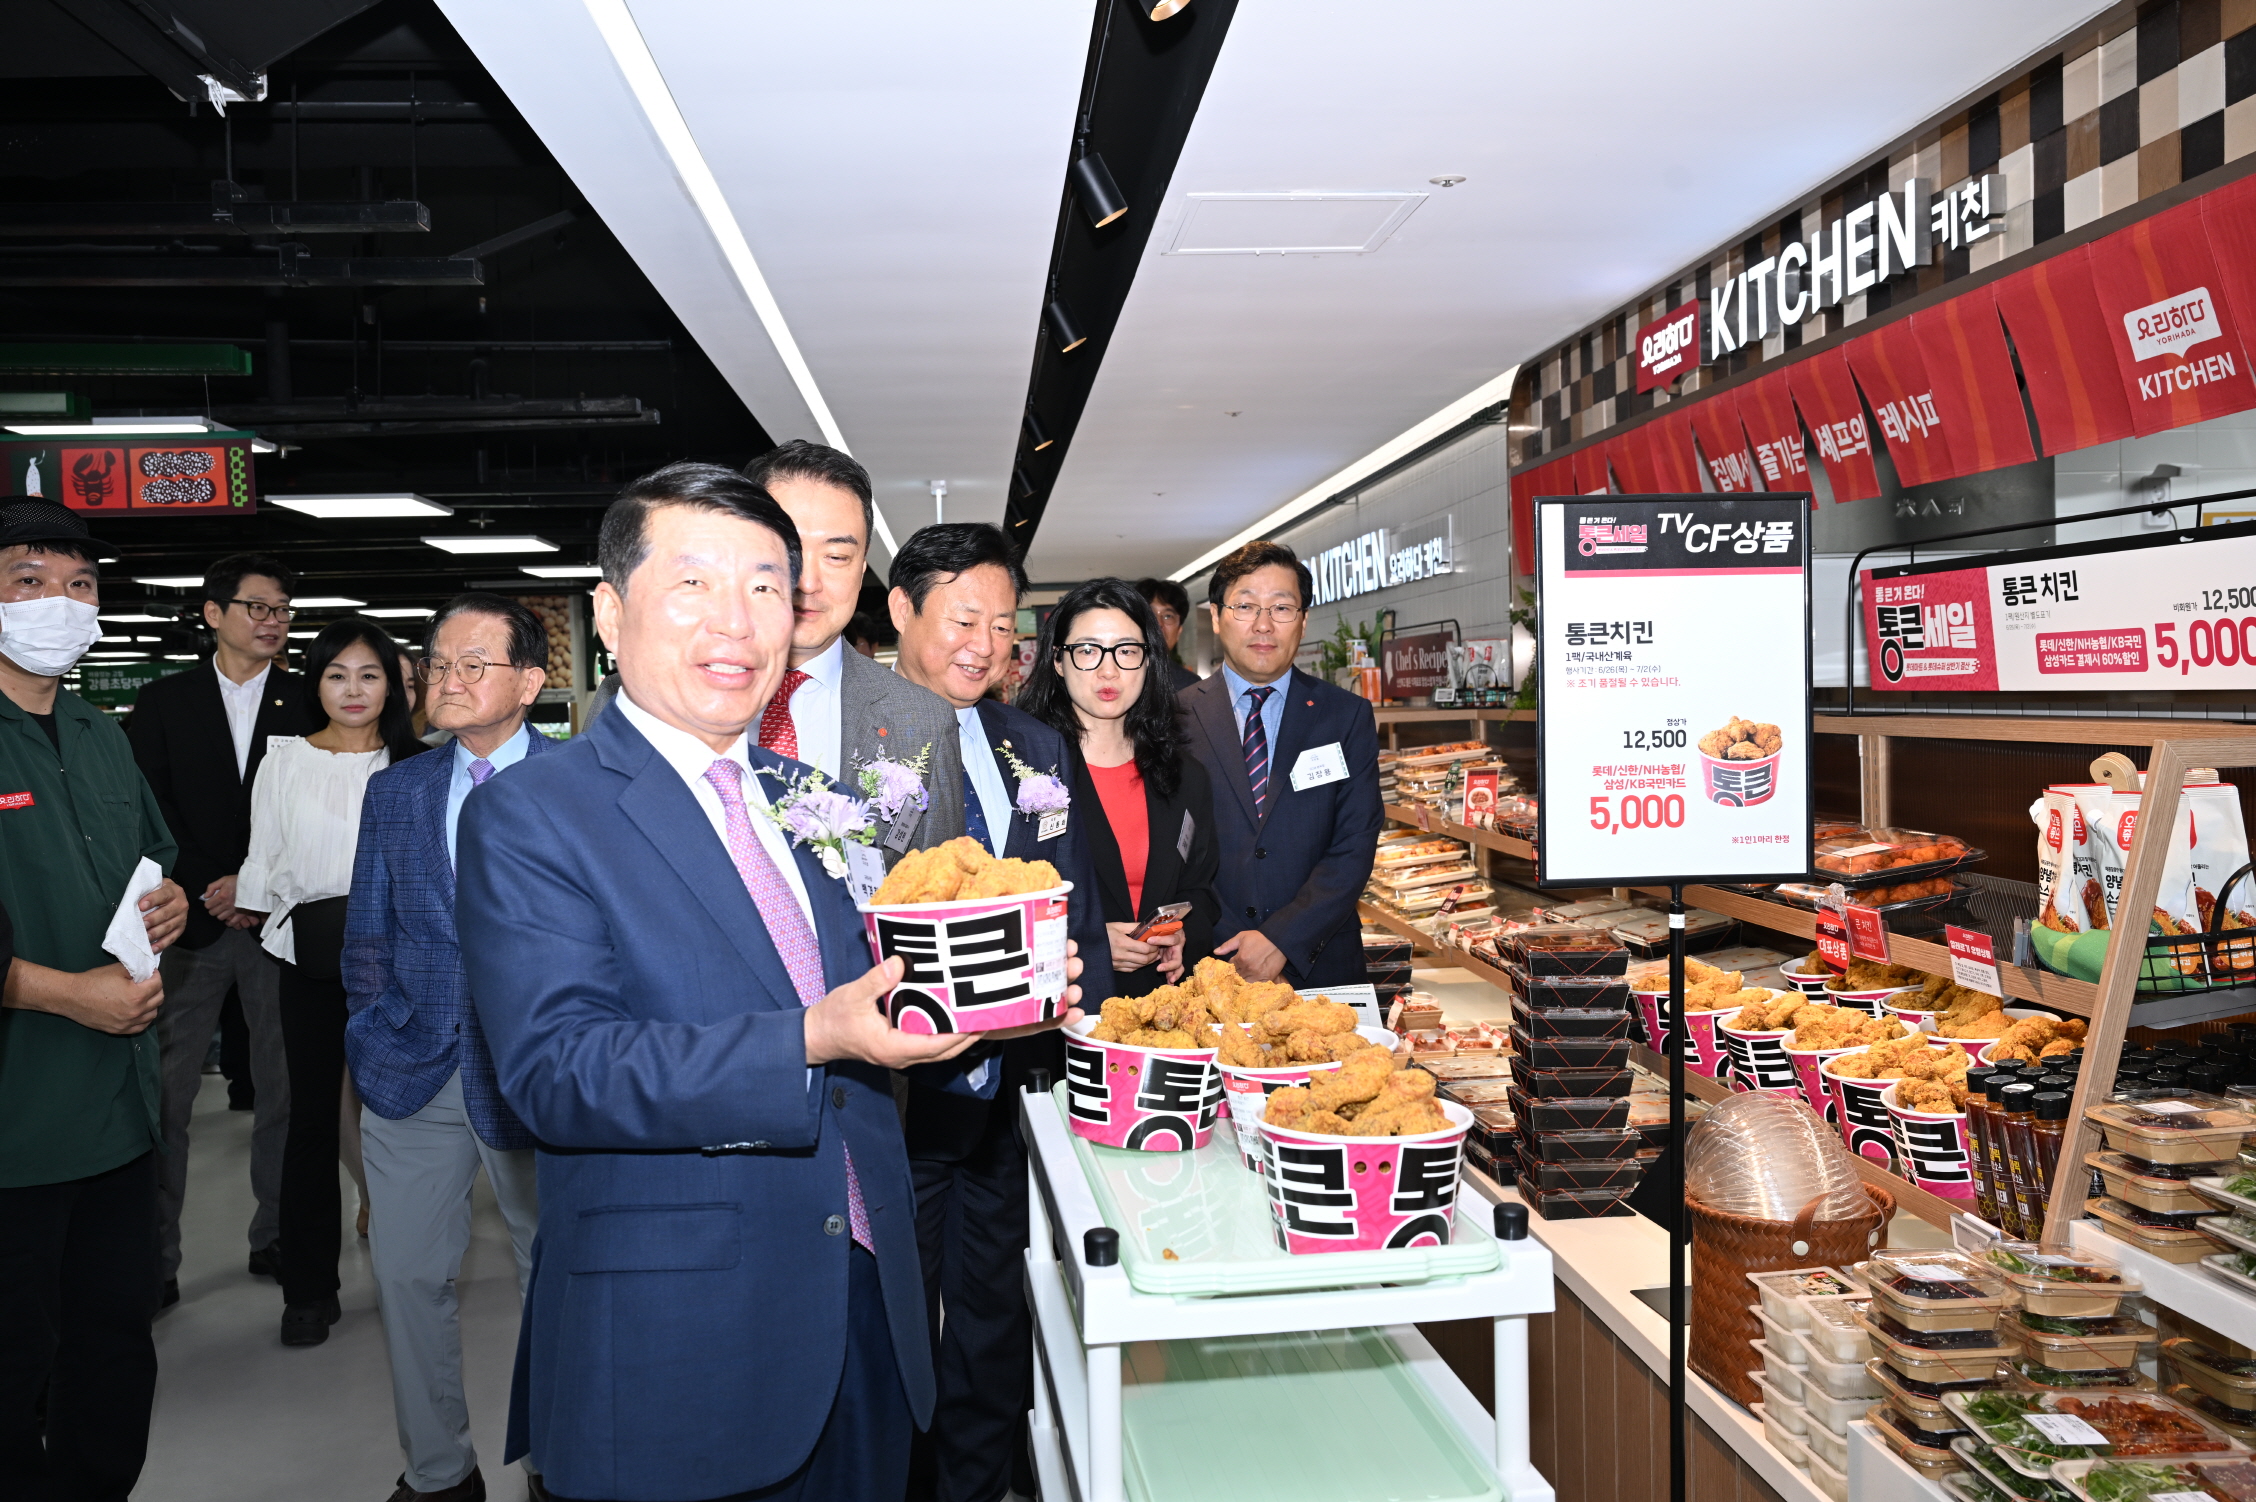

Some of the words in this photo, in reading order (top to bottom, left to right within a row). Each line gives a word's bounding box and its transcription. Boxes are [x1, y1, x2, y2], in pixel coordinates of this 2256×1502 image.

[1931, 173, 1990, 251] 키친
[1710, 177, 1916, 361] KITCHEN
[1640, 313, 1695, 368] 요리하다
[2137, 298, 2205, 341] 요리하다
[2156, 328, 2197, 345] YORIHADA
[2138, 351, 2237, 402] KITCHEN
[1578, 524, 1648, 557] 통큰세일
[1657, 512, 1694, 535] TV
[1684, 521, 1795, 554] CF상품
[1319, 528, 1387, 604] KITCHEN
[2002, 575, 2038, 606] 통큰
[2039, 569, 2080, 603] 치킨
[1565, 620, 1653, 646] 통큰치킨
[1875, 600, 1978, 684] 통큰세일
[2154, 616, 2256, 676] 5,000
[1395, 646, 1418, 672] Chef's
[2044, 654, 2076, 668] 삼성카드
[1577, 677, 1596, 688] 조기
[1629, 677, 1639, 688] 수
[1640, 676, 1681, 688] 있습니다.
[1623, 729, 1687, 752] 12,500
[1666, 718, 1687, 726] 정상가
[1603, 778, 1687, 791] 삼성/KB국민카드
[1712, 762, 1773, 807] 통큰
[1590, 793, 1685, 835] 5,000
[1774, 834, 1790, 844] 한정
[876, 906, 1034, 1034] 통큰
[1819, 938, 1847, 961] 대표상품
[1264, 1140, 1358, 1241] 큰
